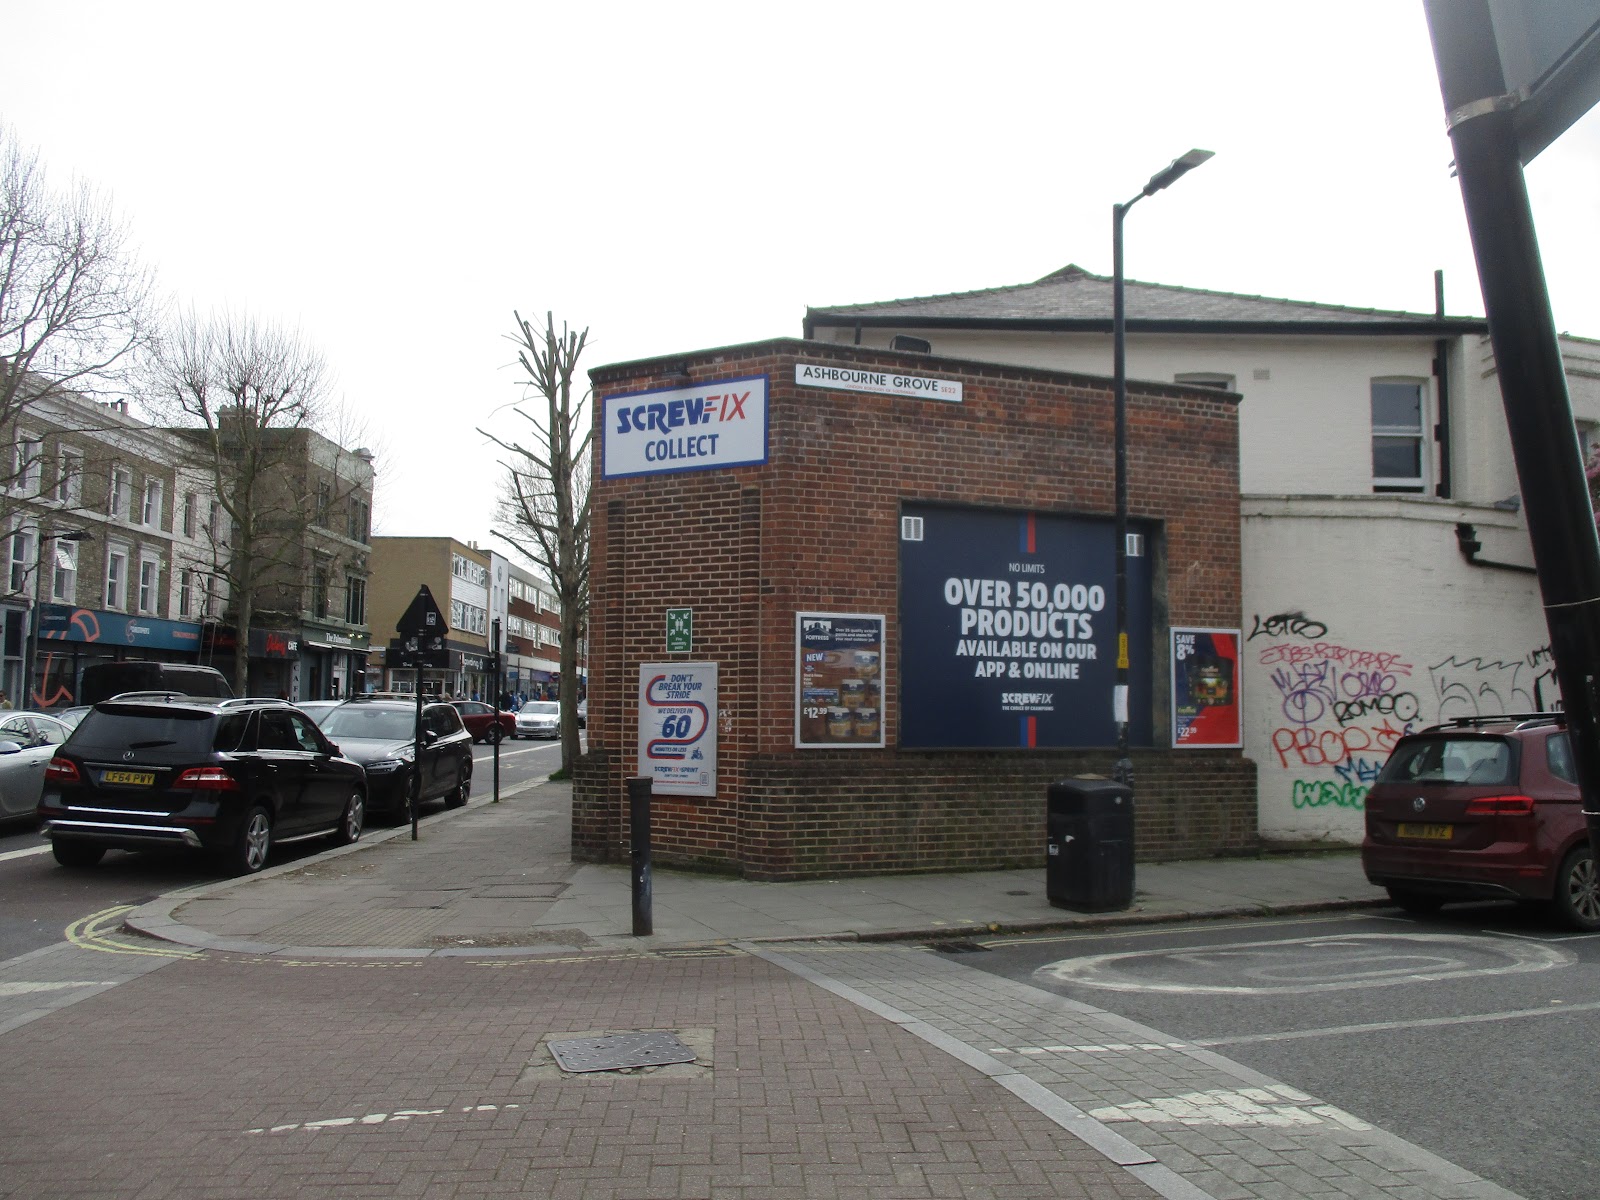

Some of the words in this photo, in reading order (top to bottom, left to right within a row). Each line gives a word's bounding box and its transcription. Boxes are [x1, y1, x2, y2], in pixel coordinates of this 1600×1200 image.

[803, 366, 887, 386] ASHBOURNE
[892, 376, 939, 391] GROVE
[941, 386, 956, 394] SE22
[617, 391, 751, 435] SCREWFIX
[645, 434, 719, 462] COLLECT
[1008, 563, 1020, 573] NO
[1021, 563, 1046, 574] LIMITS
[944, 577, 1011, 608] OVER
[1016, 581, 1105, 614] 50,000
[961, 607, 1093, 640] PRODUCTS
[1176, 634, 1195, 645] SAVE
[806, 652, 824, 662] NEW
[956, 639, 1038, 659] AVAILABLE
[1040, 642, 1062, 659] ON
[1064, 643, 1097, 660] OUR
[1176, 643, 1195, 660] 8%
[975, 661, 1006, 678] APP
[1008, 661, 1021, 678] &
[1023, 662, 1080, 680] ONLINE
[671, 674, 693, 683] DON'T
[658, 682, 683, 691] BREAK
[683, 682, 702, 691] YOUR
[665, 690, 691, 699] STRIDE
[1001, 692, 1054, 706] SCREWFIX
[803, 707, 828, 719] £12.99
[662, 714, 691, 738] 60
[105, 771, 130, 782] LF64
[133, 772, 153, 783] PWY
